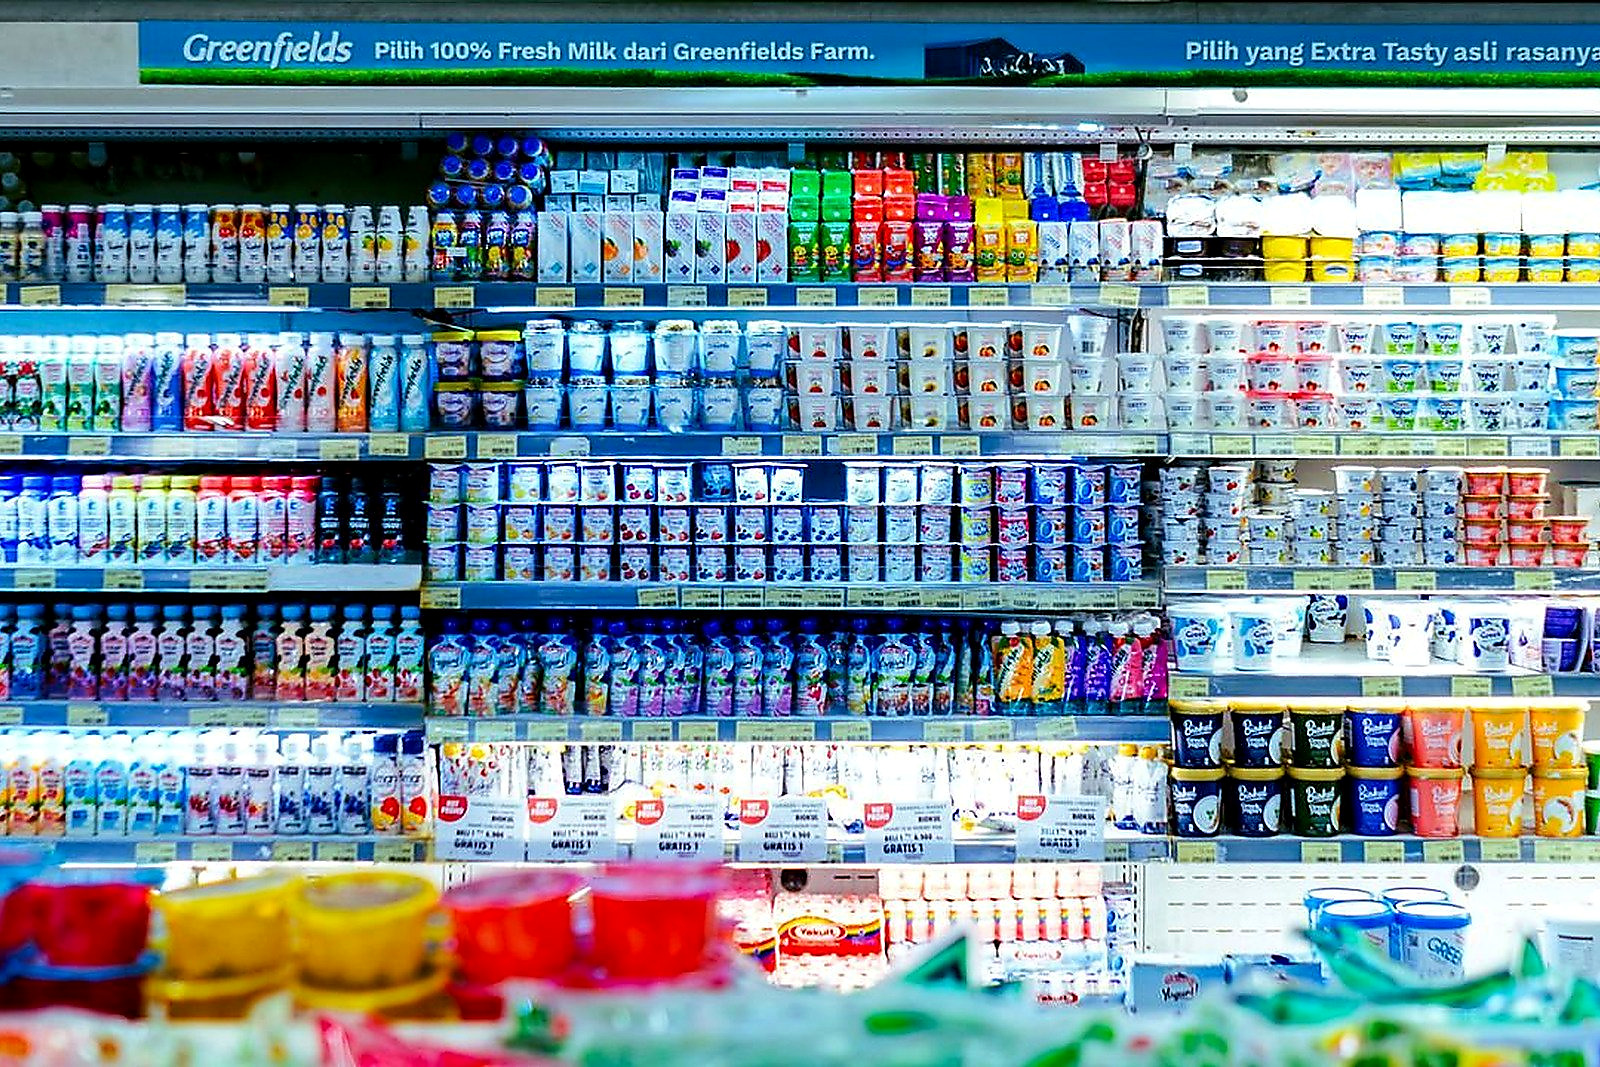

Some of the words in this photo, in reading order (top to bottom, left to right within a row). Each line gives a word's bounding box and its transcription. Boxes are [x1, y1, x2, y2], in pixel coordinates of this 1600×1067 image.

[183, 30, 353, 69] Greenfields
[375, 41, 424, 60] Pilih
[431, 42, 491, 60] 100%
[500, 42, 561, 60] Fresh
[568, 42, 616, 60] Milk
[624, 42, 667, 60] dari
[673, 42, 804, 60] Greenfields
[811, 43, 875, 60] Farm.
[1186, 40, 1238, 60] Pilih
[1245, 43, 1304, 66] yang
[1312, 42, 1376, 61] Extra
[1383, 42, 1448, 67] Tasty
[1454, 41, 1498, 61] asli
[1506, 43, 1600, 67] rasanya
[454, 841, 487, 850] GRATIS
[552, 841, 586, 850] GRATIS
[658, 842, 692, 851] GRATIS
[763, 842, 796, 850] GRATIS
[883, 844, 917, 854] GRATIS
[800, 928, 837, 936] Yakult
